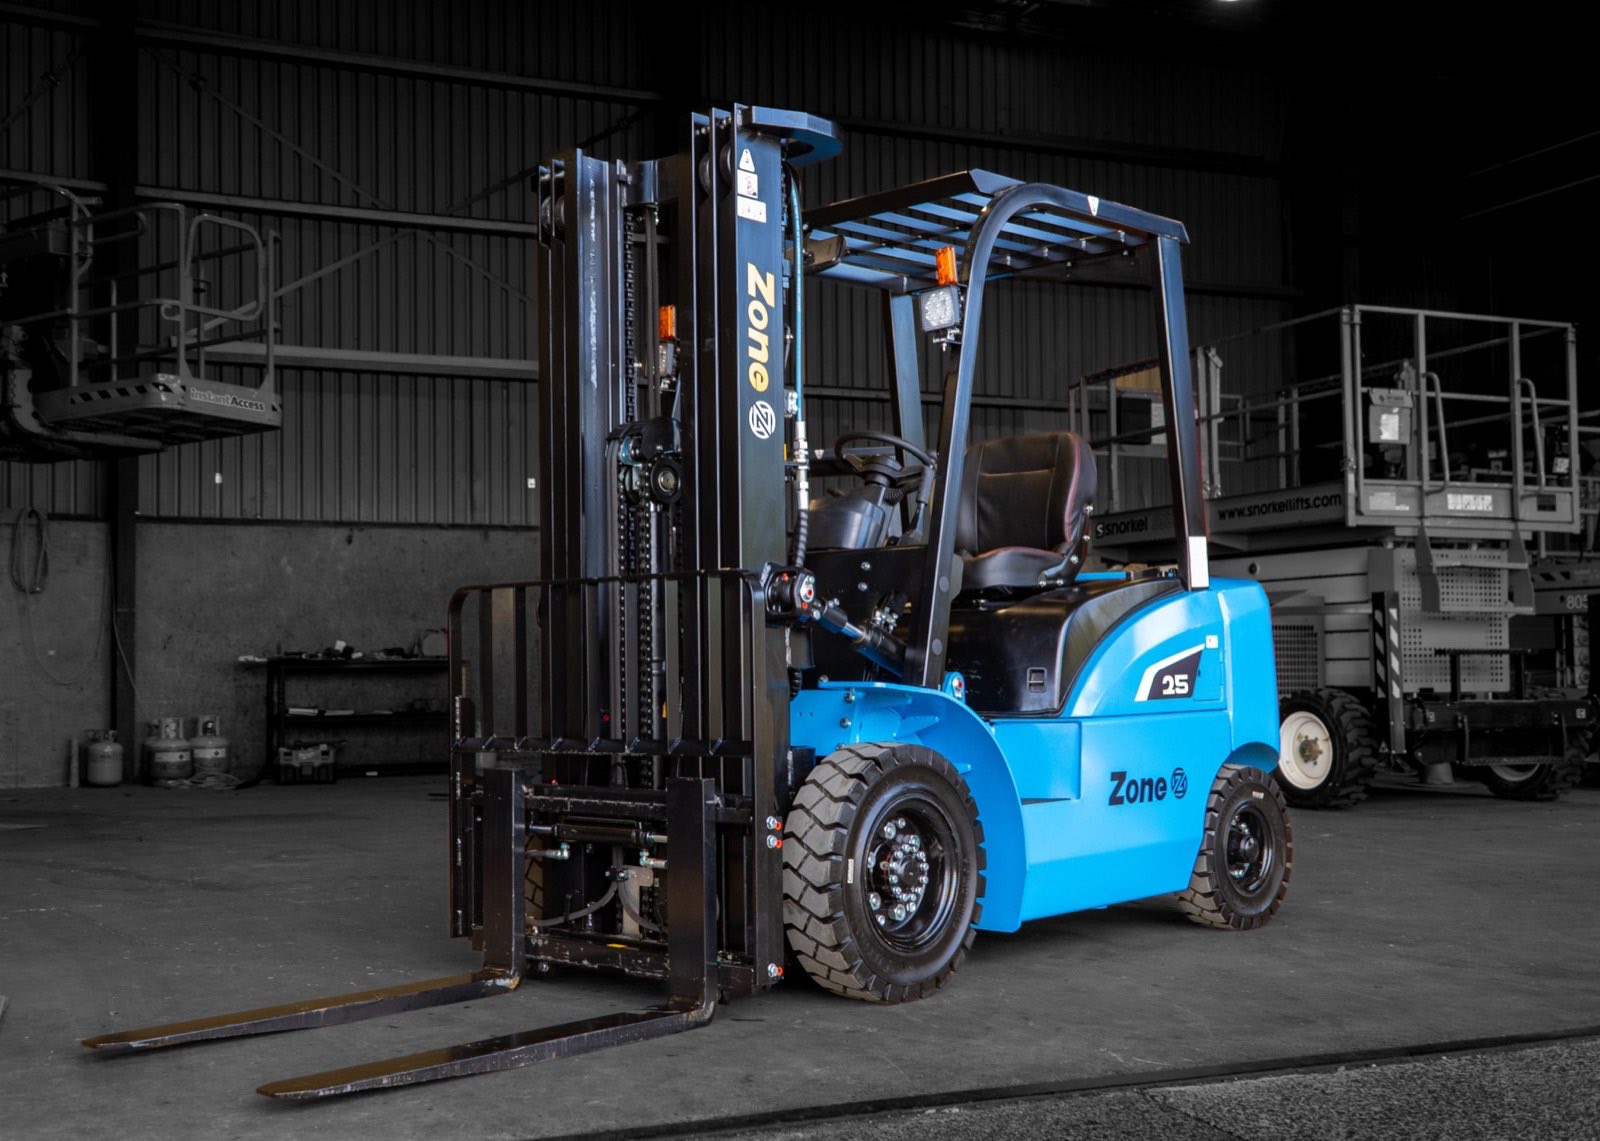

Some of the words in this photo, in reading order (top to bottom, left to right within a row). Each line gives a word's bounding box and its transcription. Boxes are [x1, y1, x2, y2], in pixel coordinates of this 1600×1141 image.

[747, 262, 775, 393] Zone
[1218, 493, 1342, 520] www.snorkellifts.com
[1106, 517, 1148, 536] snorkel
[1162, 674, 1189, 695] 25
[1108, 771, 1167, 806] Zone
